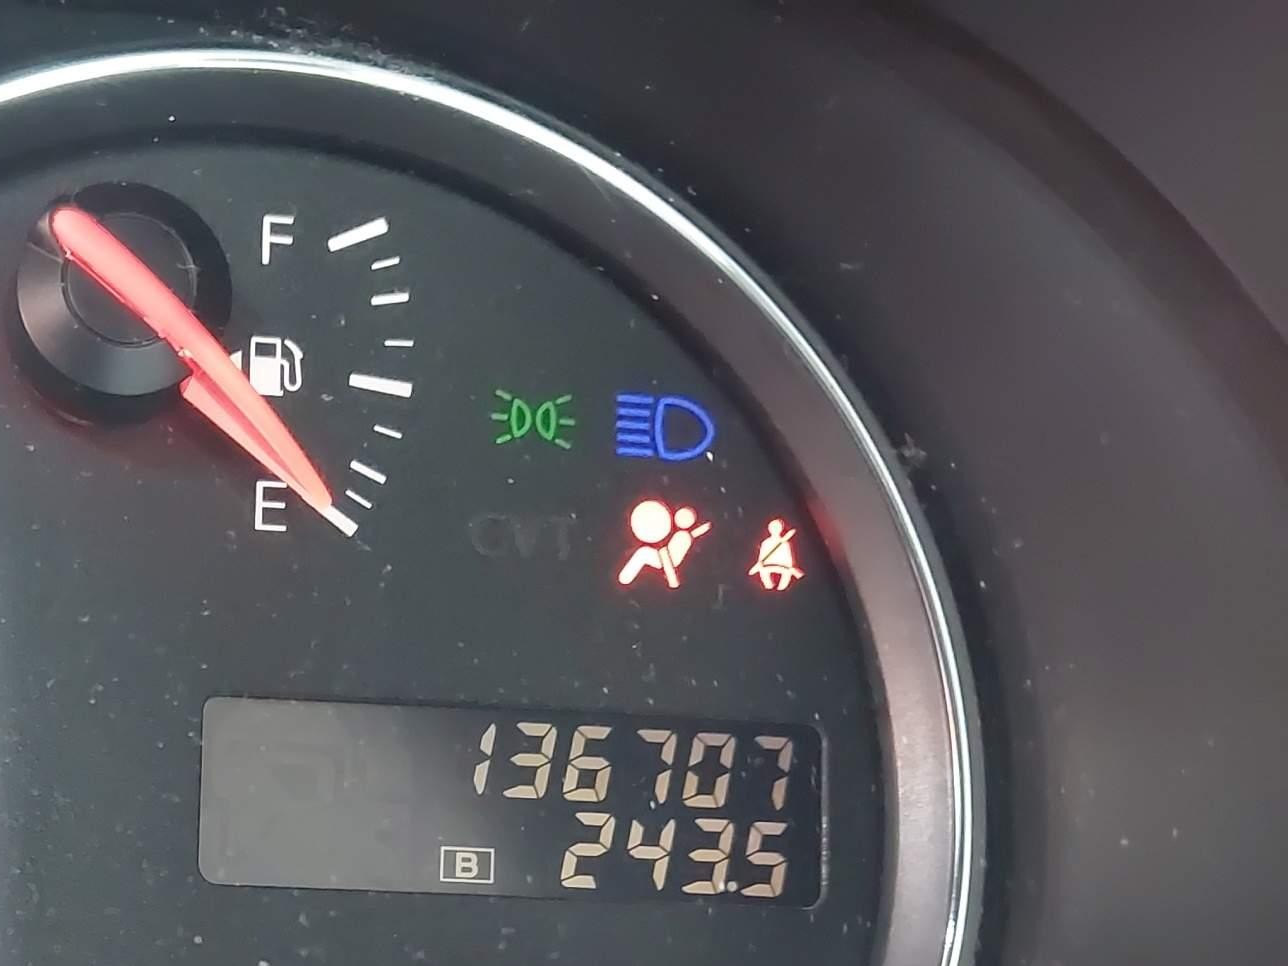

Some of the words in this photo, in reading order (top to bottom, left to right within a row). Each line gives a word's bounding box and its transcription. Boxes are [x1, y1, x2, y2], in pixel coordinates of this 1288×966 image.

[261, 215, 294, 264] F
[255, 482, 288, 531] E
[473, 722, 792, 810] 136707
[456, 855, 478, 878] B
[561, 812, 788, 897] 243.5
